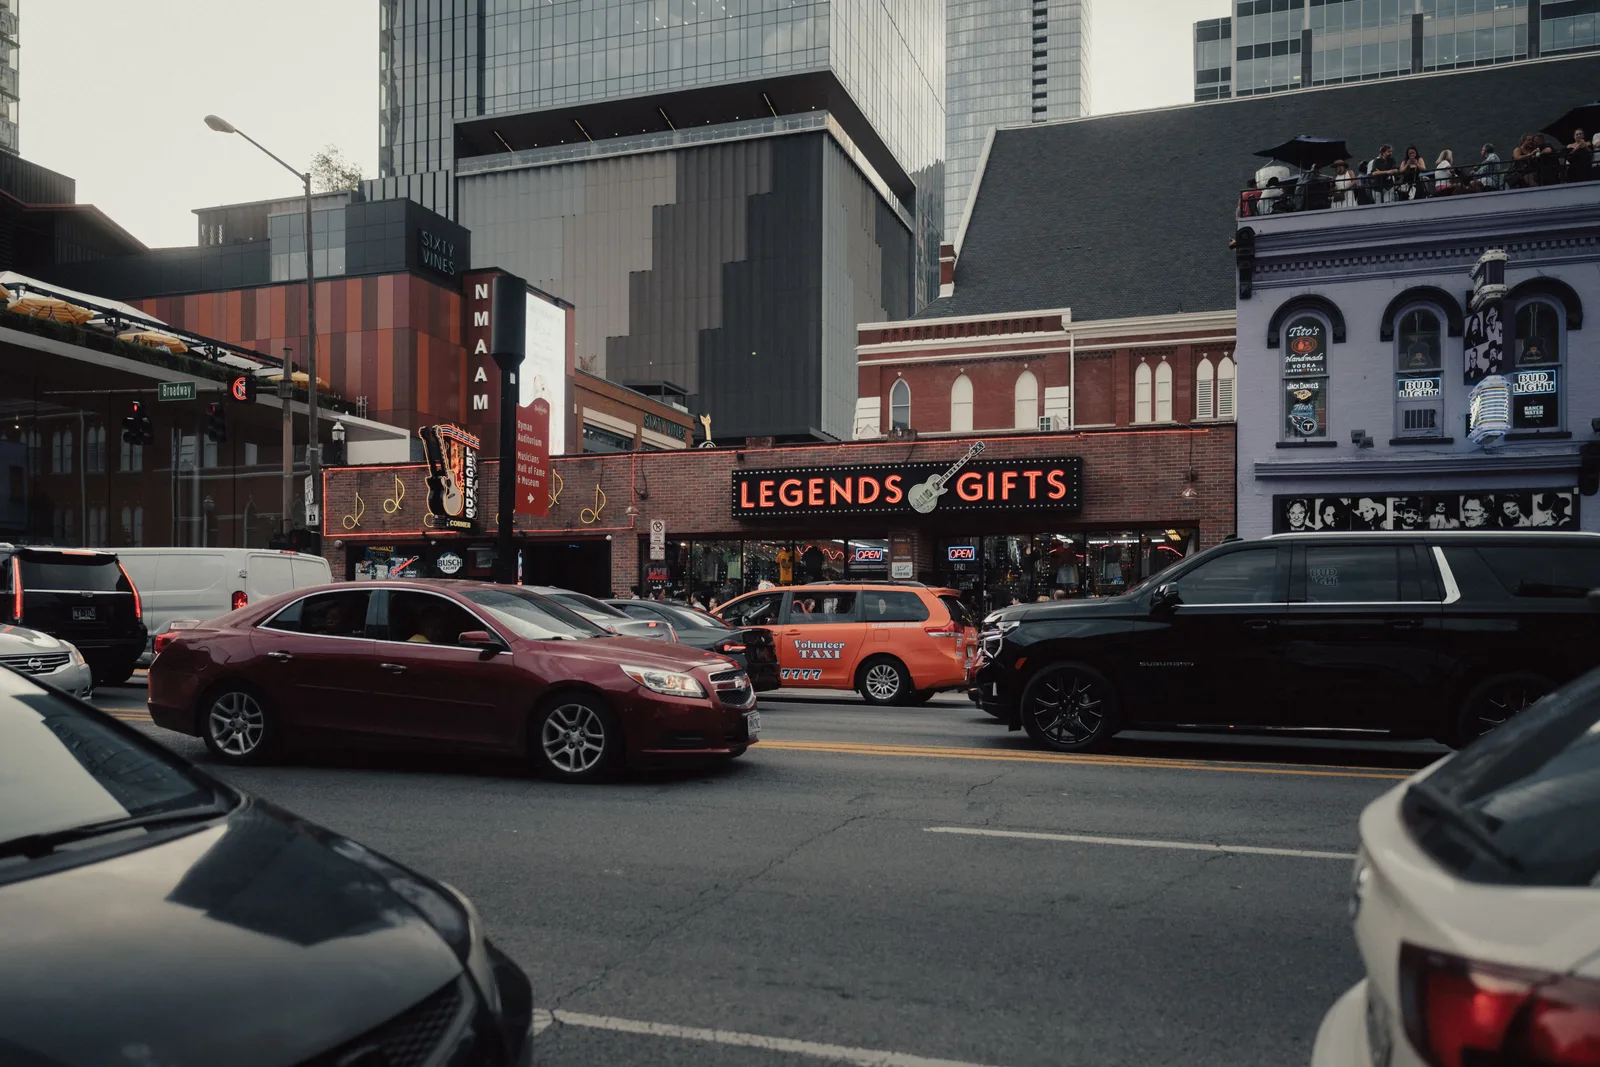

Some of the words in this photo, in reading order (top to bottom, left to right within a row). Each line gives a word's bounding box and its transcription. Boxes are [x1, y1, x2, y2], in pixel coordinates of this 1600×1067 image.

[422, 230, 455, 257] SIXTY
[423, 248, 455, 276] VINES
[1289, 325, 1320, 337] Tito's
[1285, 352, 1324, 363] Handmade
[1518, 372, 1548, 383] BUD
[162, 383, 192, 399] Broadway
[1405, 380, 1434, 391] BUD
[517, 420, 533, 432] Ryman
[644, 413, 665, 433] SIXTY
[666, 421, 687, 441] VINES
[517, 433, 542, 447] Auditorium
[517, 451, 540, 464] Musicians
[517, 463, 527, 473] Hall
[527, 465, 533, 473] of
[533, 466, 545, 478] Fame
[465, 446, 475, 519] LEGENDS
[521, 476, 540, 488] Museum
[740, 474, 903, 509] LEGENDS
[956, 469, 1067, 502] GIFTS
[857, 550, 882, 560] OPEN
[949, 549, 974, 559] OPEN
[437, 558, 462, 567] BUSCH
[794, 639, 845, 649] Volunteer
[798, 649, 841, 659] TAXI
